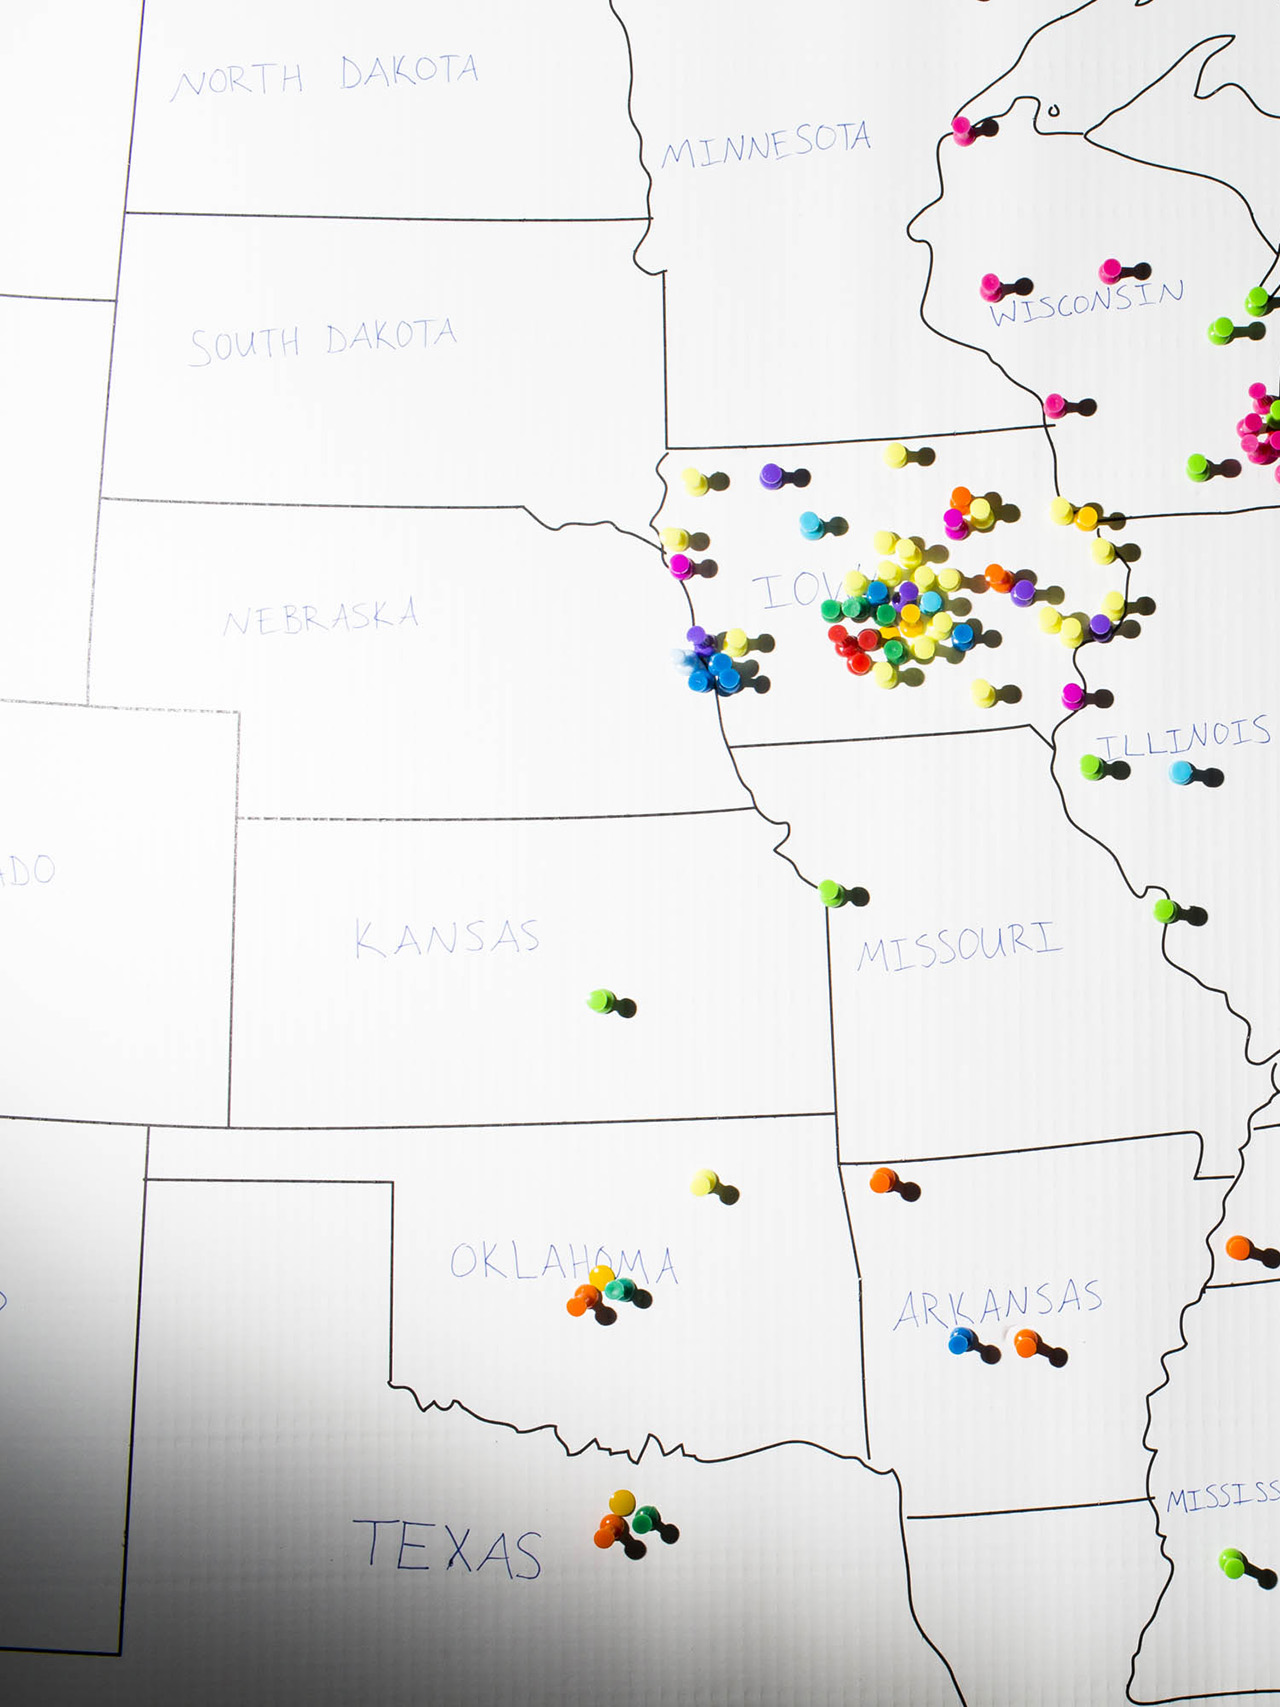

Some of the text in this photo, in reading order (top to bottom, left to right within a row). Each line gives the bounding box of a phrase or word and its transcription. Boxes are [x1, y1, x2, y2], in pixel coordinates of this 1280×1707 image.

[169, 54, 480, 103] NORTH DAKOTA
[661, 121, 872, 168] MINNESOTA
[989, 279, 1184, 327] WISCONSIN
[188, 318, 458, 368] SOUTH DAKOTA
[222, 596, 419, 638] NEBRASKA
[1095, 714, 1271, 760] ILLINOIS
[354, 918, 541, 959] KANSAS
[857, 920, 1064, 973] MISSOURI
[451, 1240, 679, 1285] OKLAHOMA
[893, 1279, 1103, 1332] ARKANSAS
[353, 1519, 542, 1580] TEXAS
